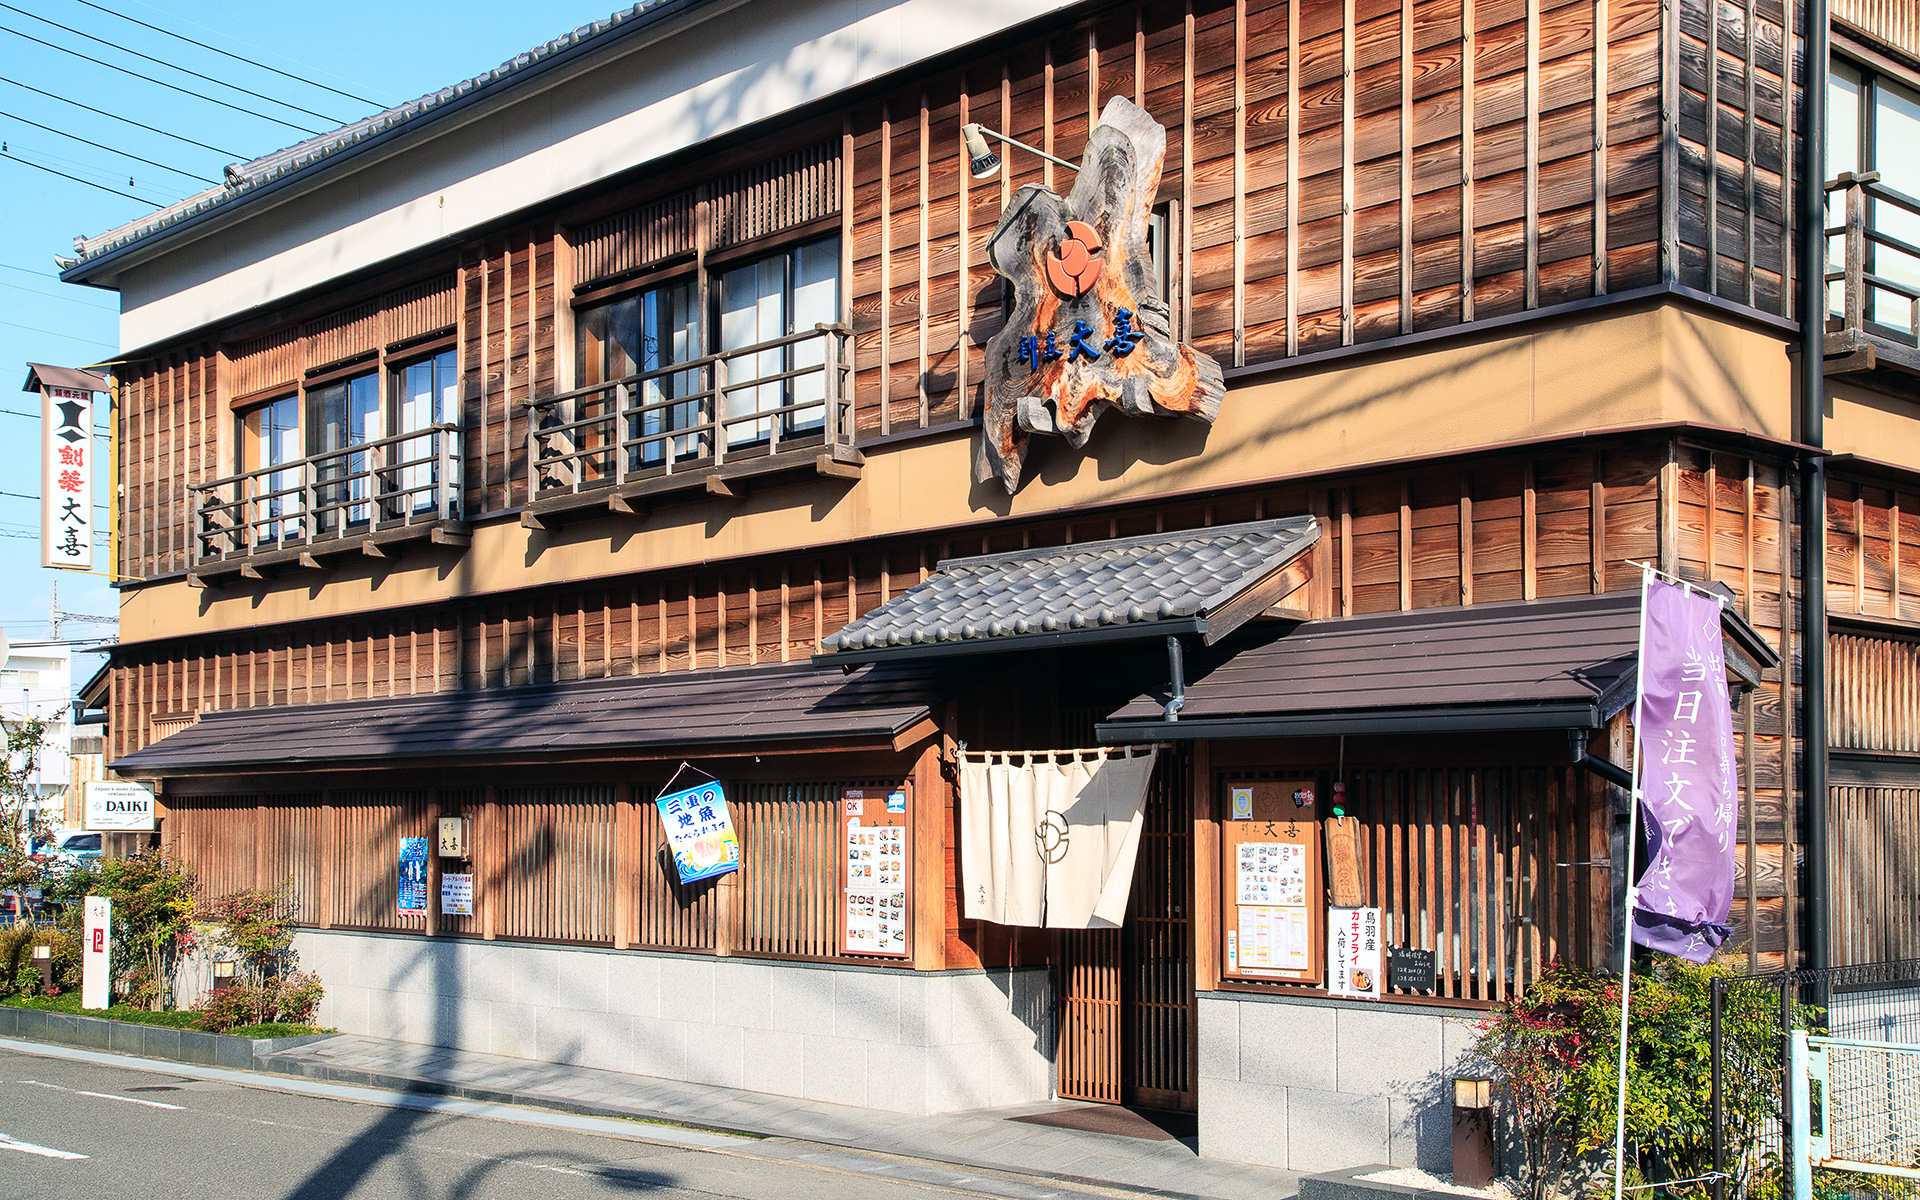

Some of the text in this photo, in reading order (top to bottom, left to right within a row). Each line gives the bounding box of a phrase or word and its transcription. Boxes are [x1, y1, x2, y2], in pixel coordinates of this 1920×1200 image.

[56, 497, 88, 557] 大喜
[106, 801, 148, 811] DAIKI
[667, 790, 716, 815] 三重の
[846, 801, 858, 811] OK
[677, 805, 717, 829] 地魚
[674, 820, 726, 843] たべられます
[440, 836, 459, 851] 大喜
[95, 931, 102, 950] P
[1350, 910, 1360, 965] カキフライ
[1337, 927, 1346, 990] 入荷してます
